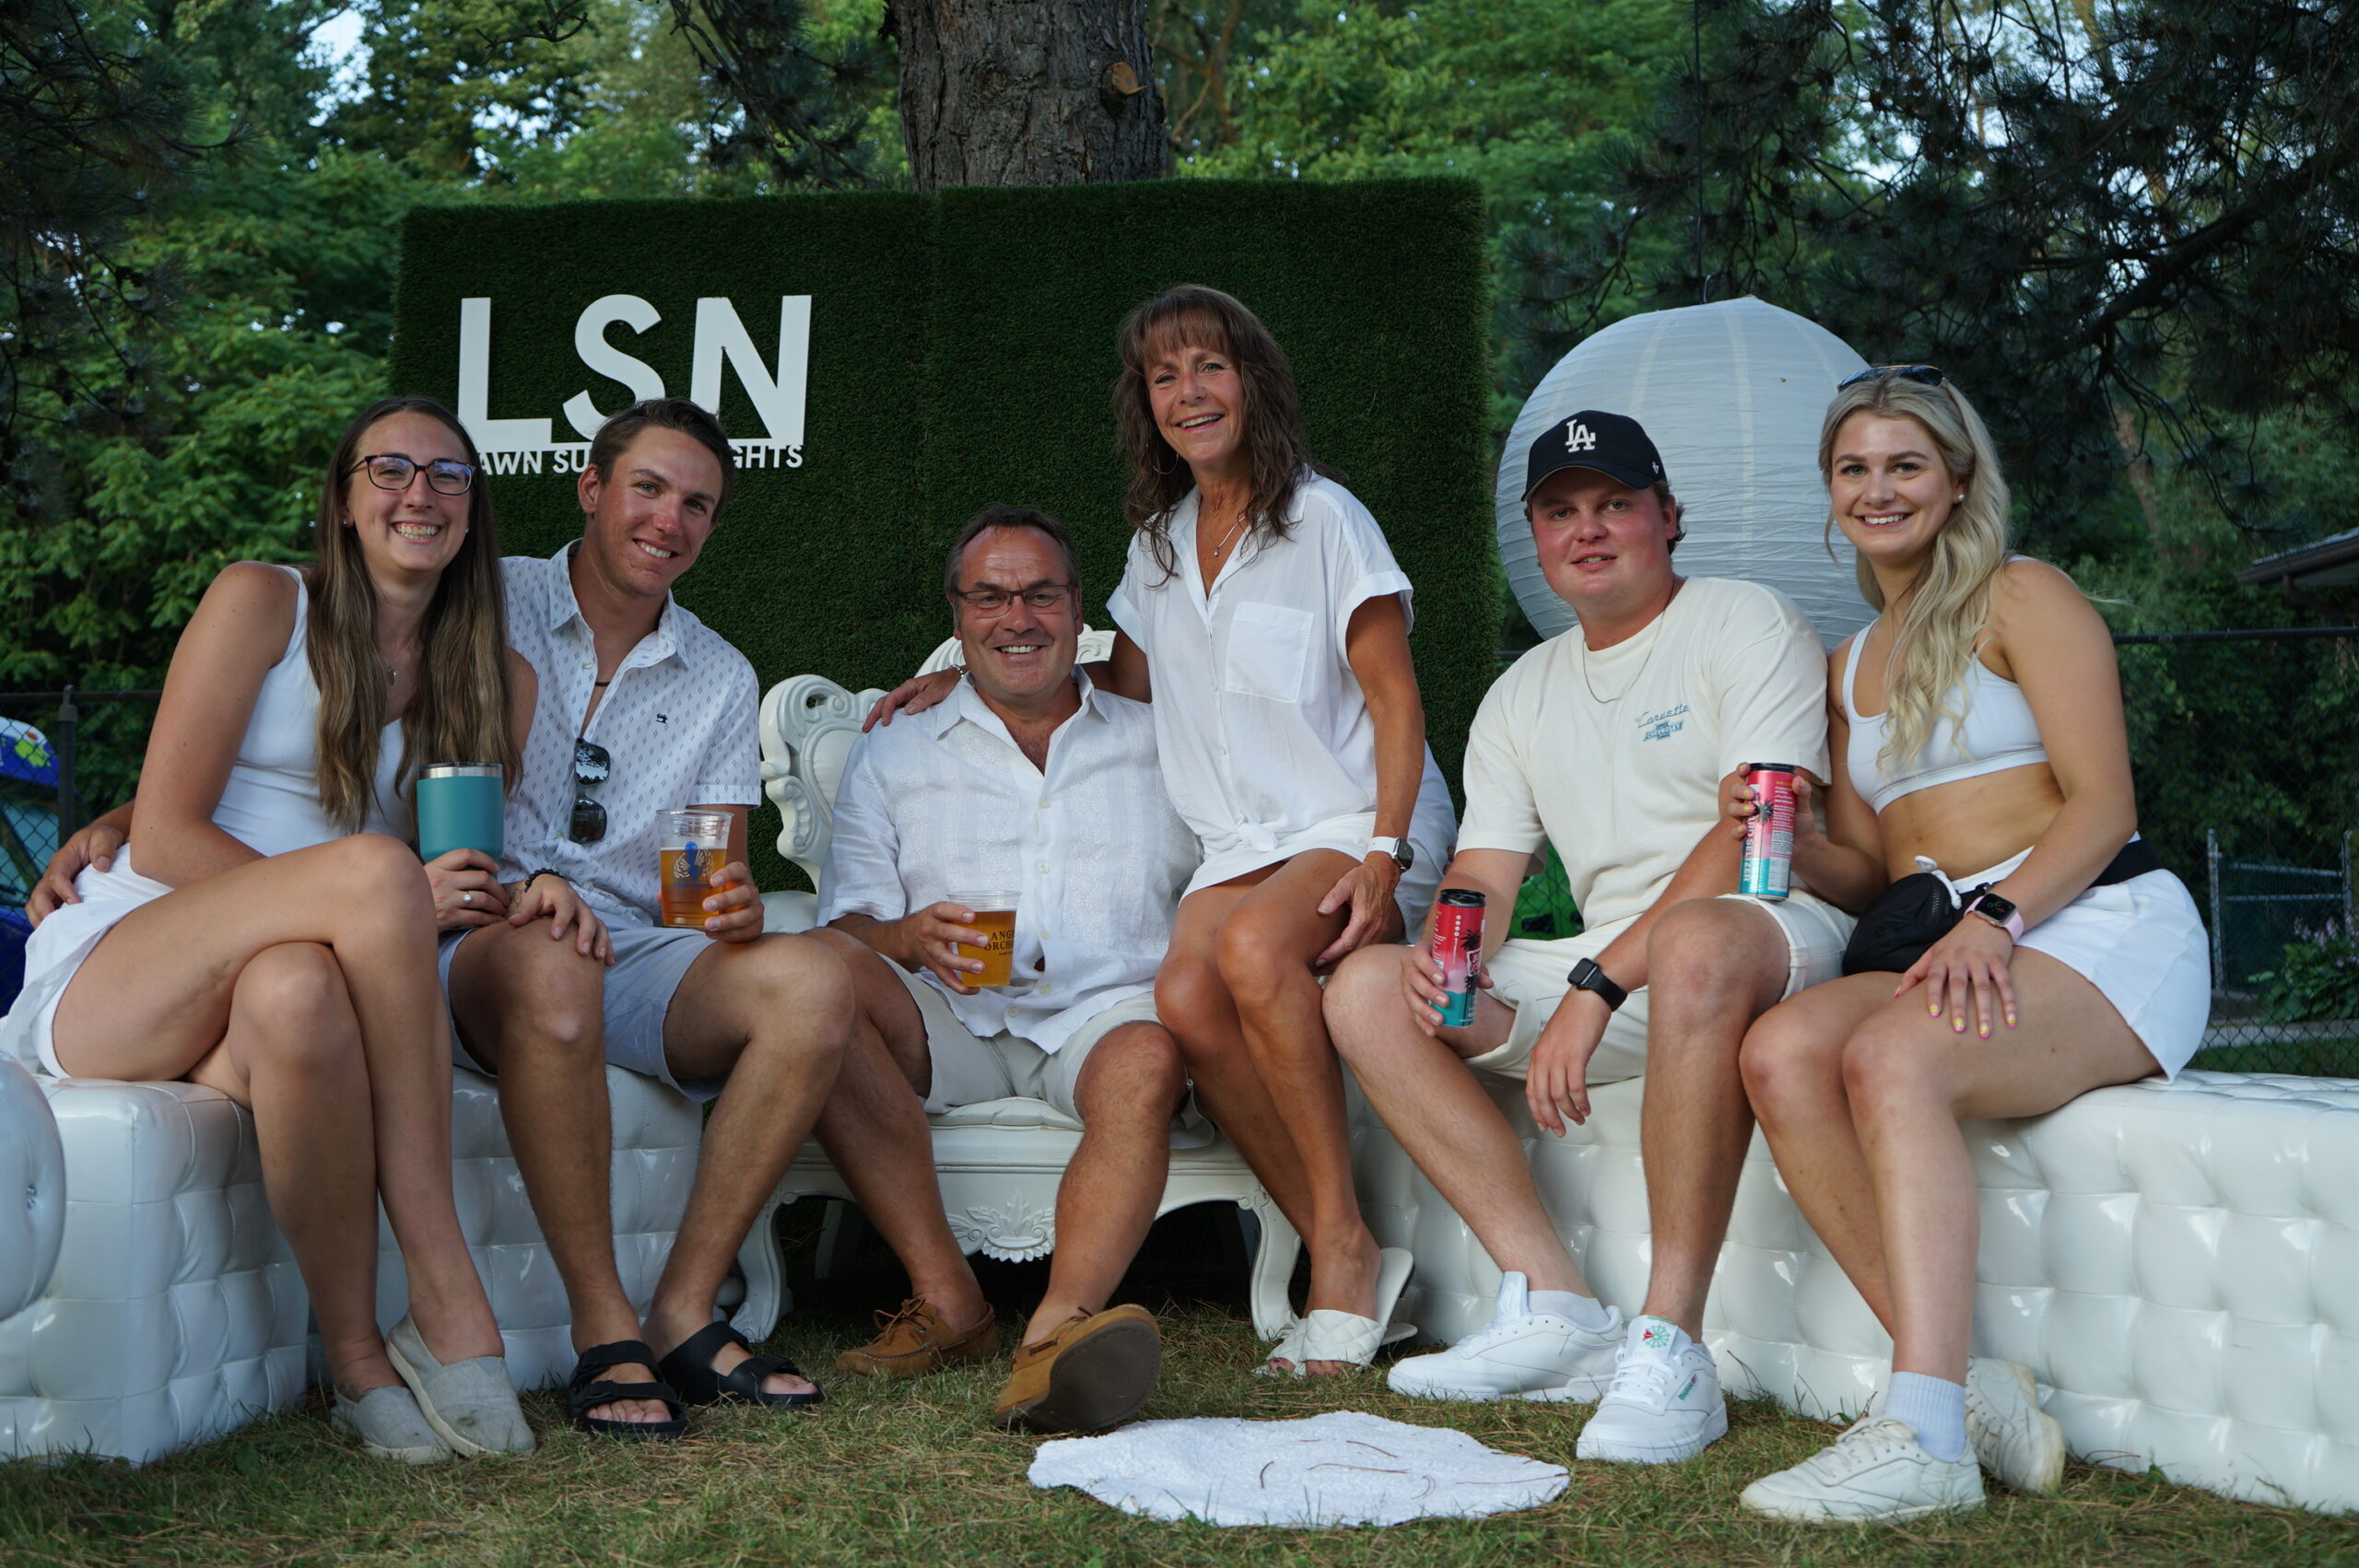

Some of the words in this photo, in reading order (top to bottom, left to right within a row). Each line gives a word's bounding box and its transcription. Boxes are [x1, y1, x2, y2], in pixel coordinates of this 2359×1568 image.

[457, 294, 813, 452] LSN
[1565, 418, 1597, 453] LA
[478, 450, 542, 475] AWN
[732, 444, 804, 469] GHTS
[1743, 839, 1754, 882] SELTZER
